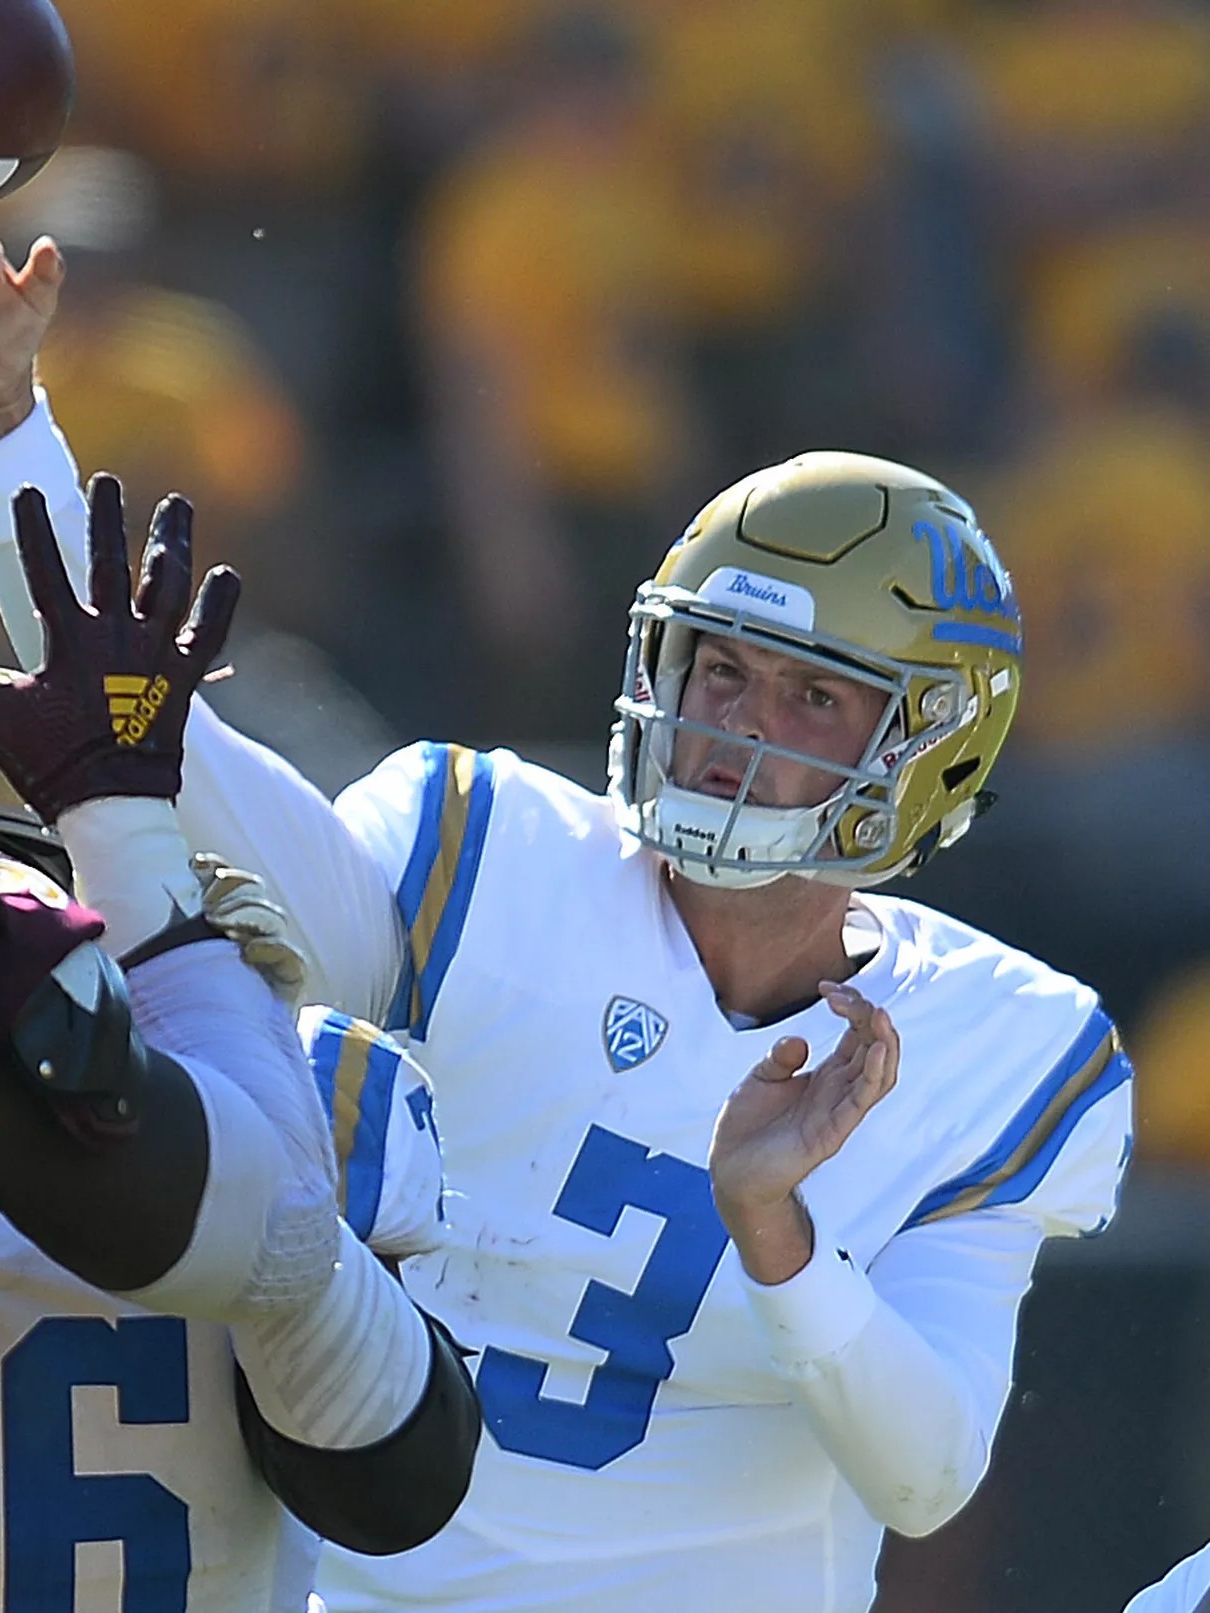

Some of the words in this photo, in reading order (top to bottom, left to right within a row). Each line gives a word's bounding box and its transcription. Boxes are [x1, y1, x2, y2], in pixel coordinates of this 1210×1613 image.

[726, 573, 787, 607] Bruins
[116, 674, 169, 746] adidas
[476, 1122, 730, 1471] 3
